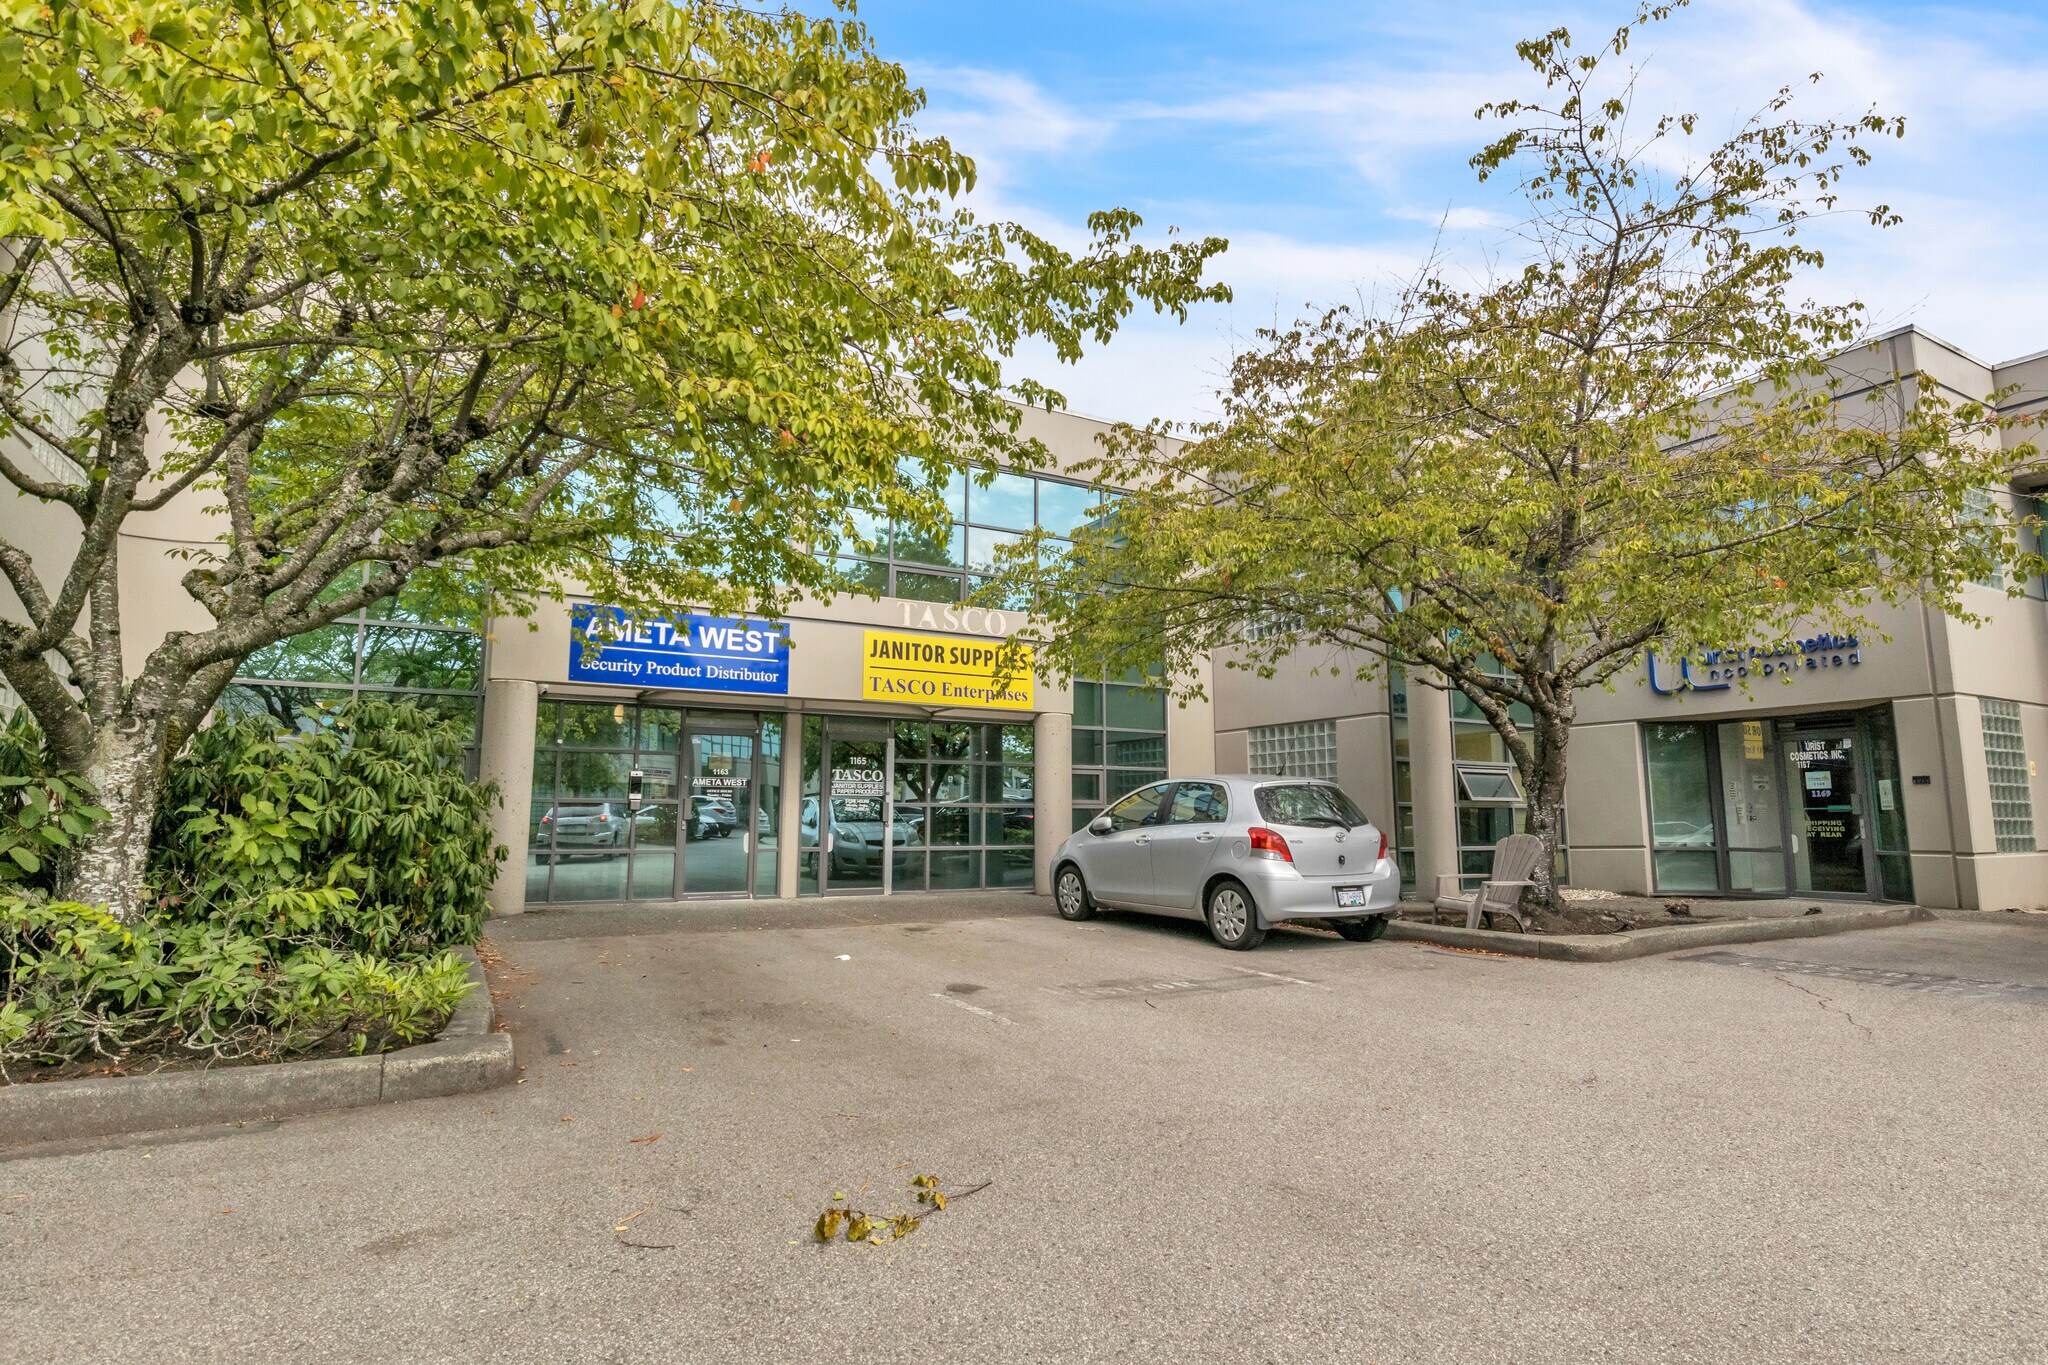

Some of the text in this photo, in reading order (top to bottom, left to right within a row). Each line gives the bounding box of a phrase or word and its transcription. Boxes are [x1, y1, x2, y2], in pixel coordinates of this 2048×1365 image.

[897, 601, 1006, 636] TASCO
[699, 626, 780, 654] WEST
[870, 640, 945, 664] JANITOR
[646, 661, 701, 678] Product
[706, 666, 779, 683] Distributor
[870, 676, 936, 696] TASCO
[1790, 750, 1845, 761] COSMETICS INC.
[1804, 741, 1825, 751] URIST
[832, 769, 883, 782] TASCO
